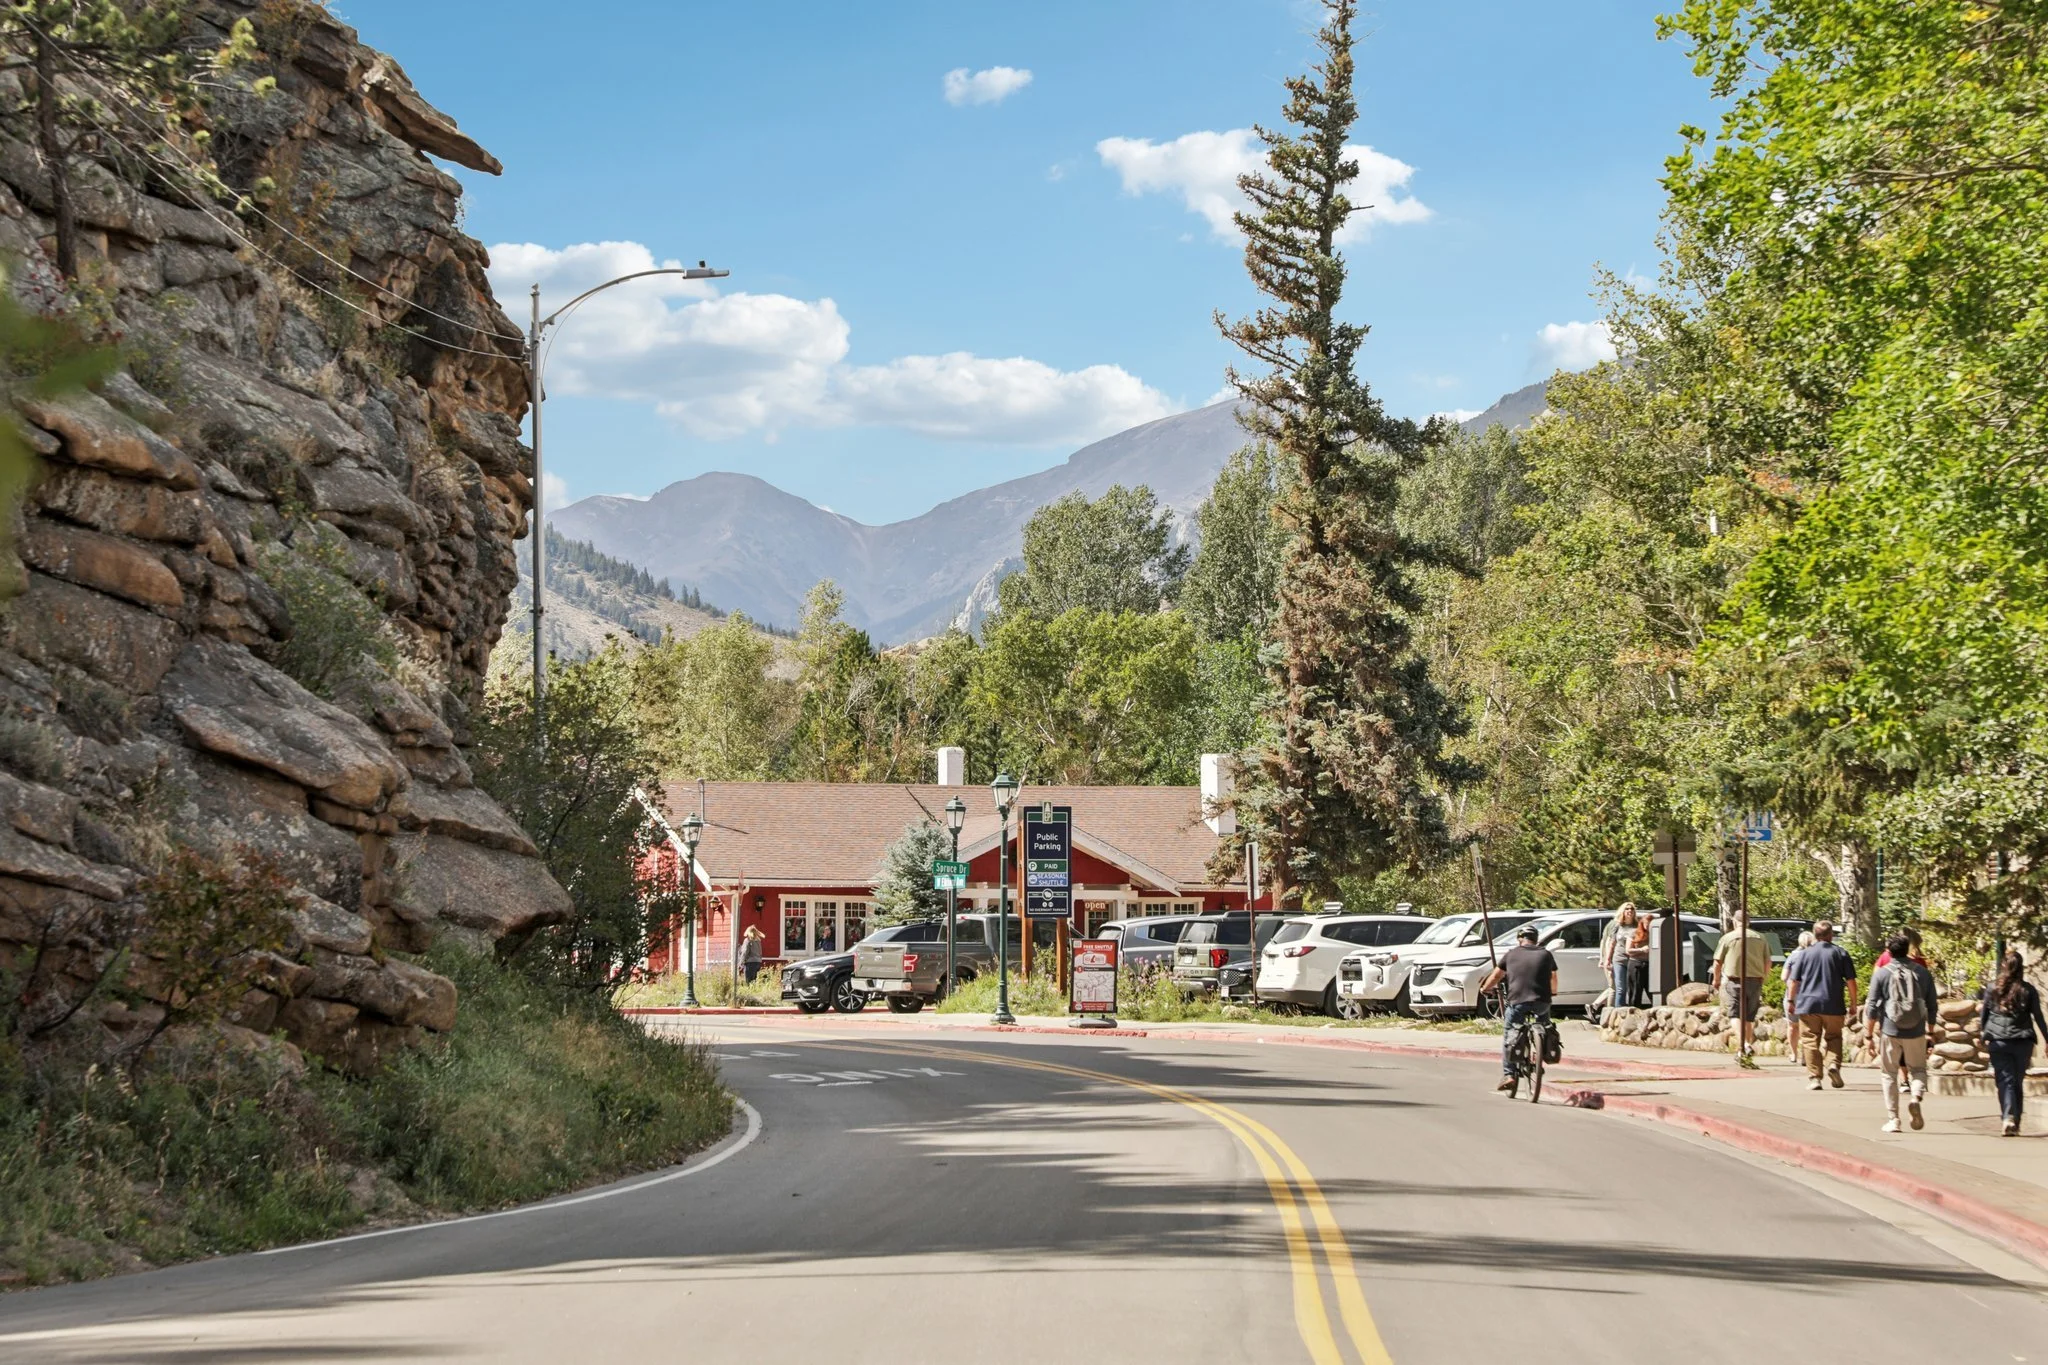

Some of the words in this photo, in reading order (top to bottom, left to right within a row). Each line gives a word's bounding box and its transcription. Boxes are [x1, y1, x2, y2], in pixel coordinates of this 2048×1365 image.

[1036, 833, 1059, 841] Public
[1033, 842, 1062, 852] Parking
[936, 862, 957, 874] Spruce
[959, 864, 967, 875] Dr
[1084, 902, 1106, 911] open
